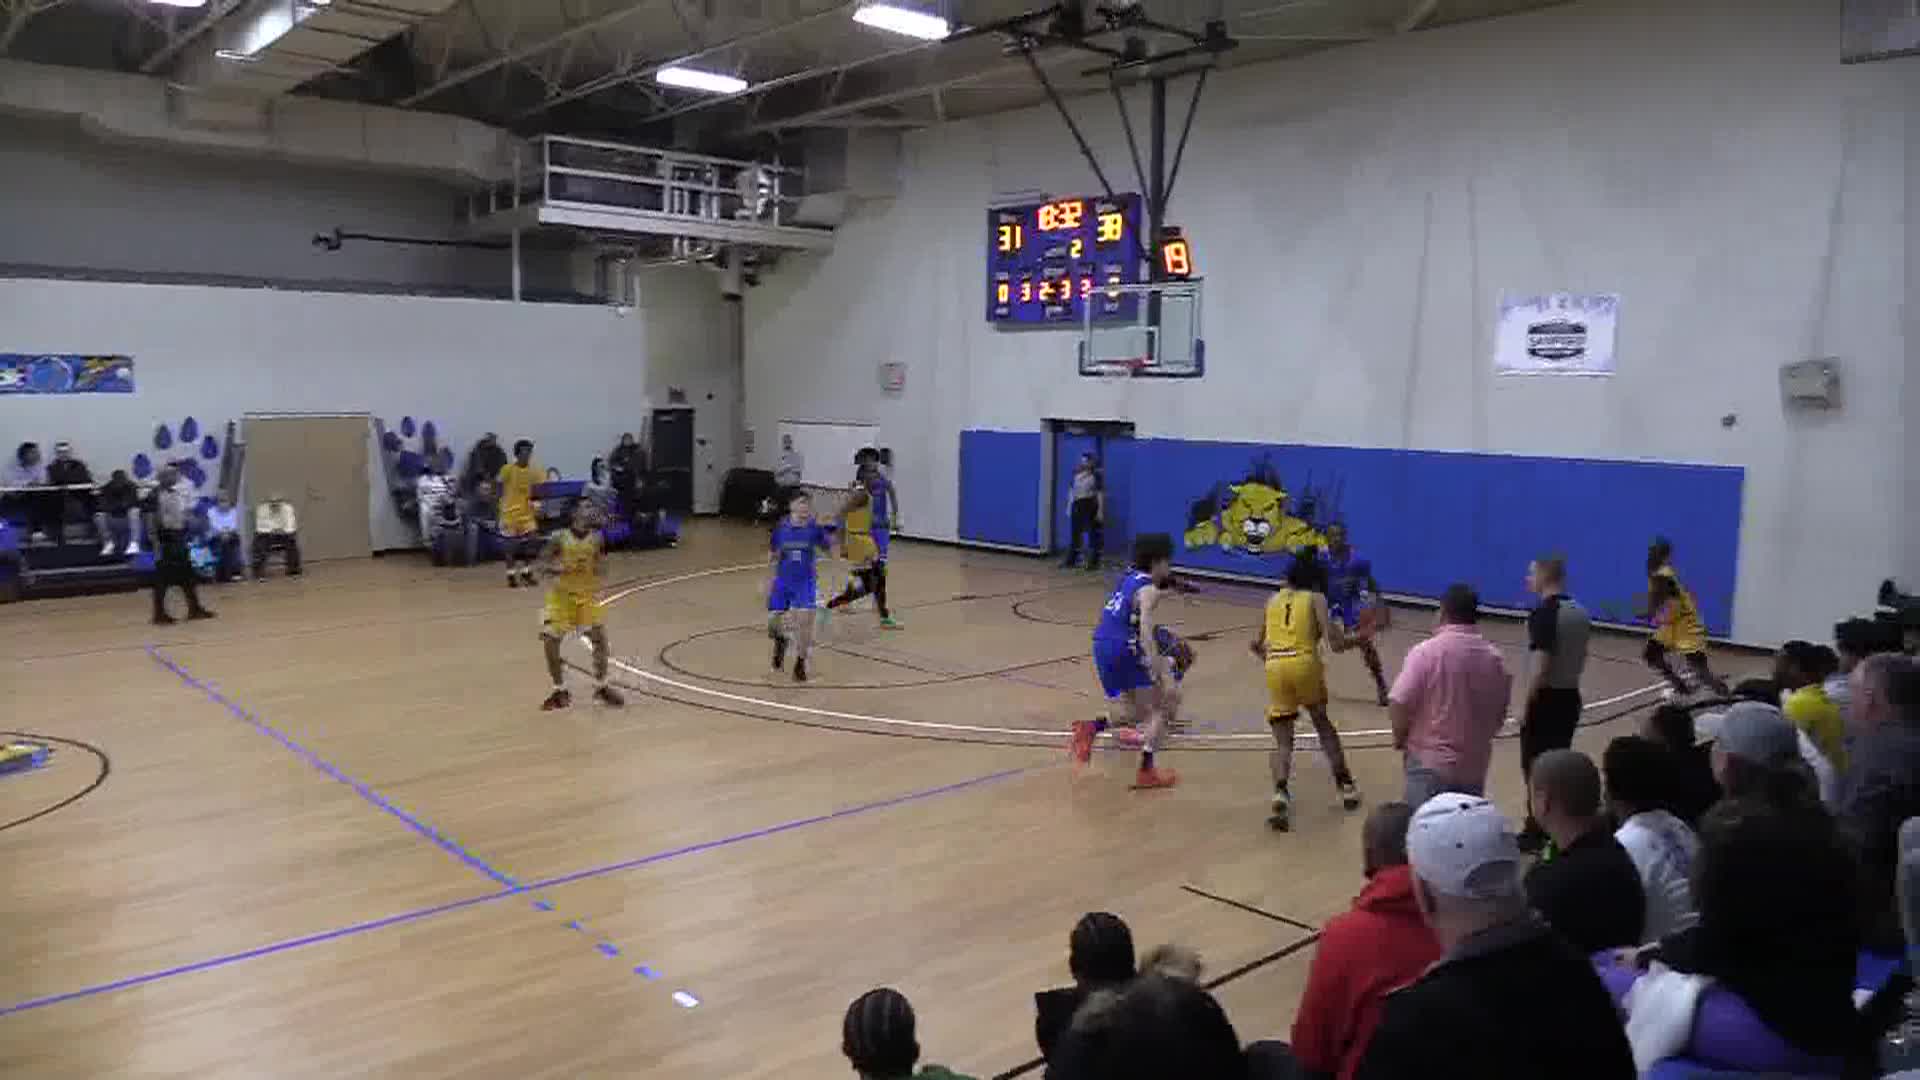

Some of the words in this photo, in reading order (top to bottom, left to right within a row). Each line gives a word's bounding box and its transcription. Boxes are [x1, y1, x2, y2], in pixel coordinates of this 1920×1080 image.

[998, 226, 1021, 251] 31
[1097, 213, 1122, 242] 38
[1071, 240, 1082, 258] 2
[1165, 242, 1189, 274] 19
